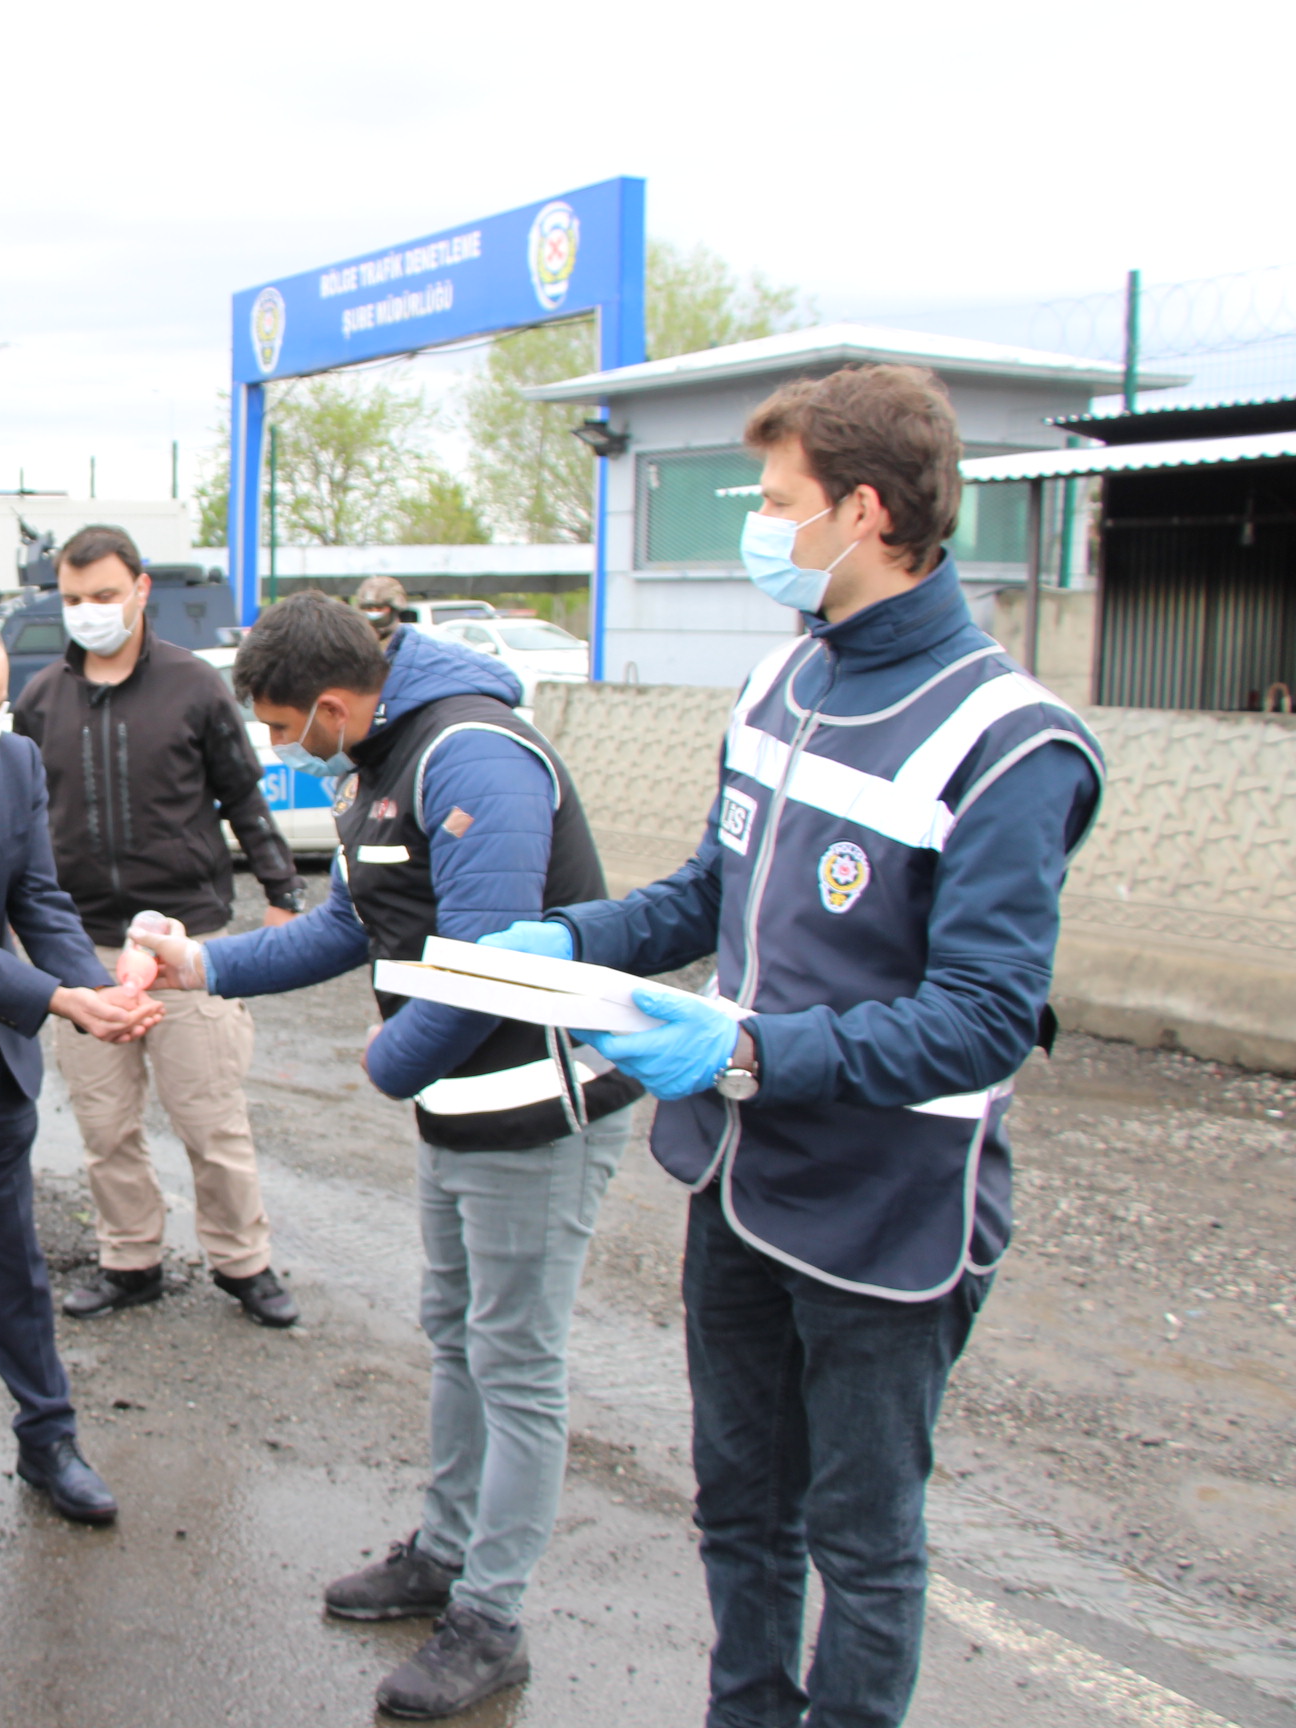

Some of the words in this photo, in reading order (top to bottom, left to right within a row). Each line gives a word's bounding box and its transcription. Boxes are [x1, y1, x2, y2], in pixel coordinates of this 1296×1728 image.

[320, 268, 358, 299] BÖLGE
[359, 251, 404, 287] TRAFİK
[405, 230, 482, 275] DENETLEME
